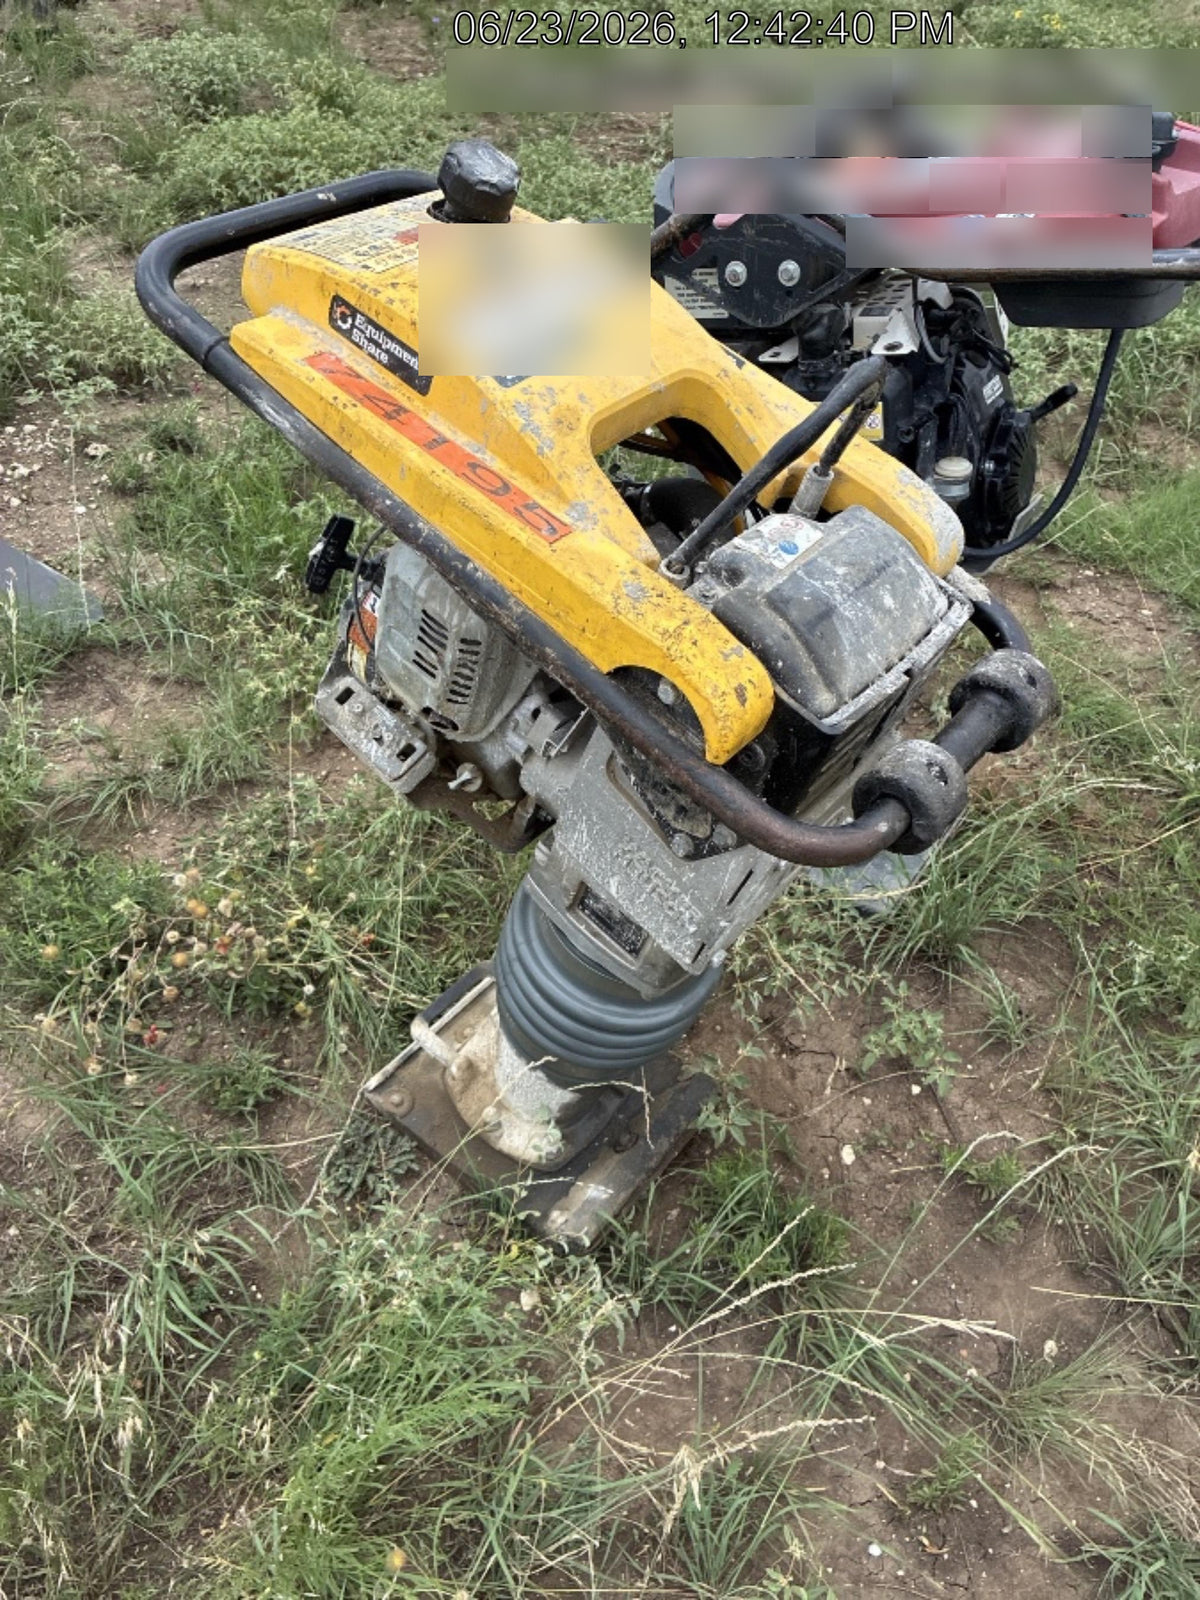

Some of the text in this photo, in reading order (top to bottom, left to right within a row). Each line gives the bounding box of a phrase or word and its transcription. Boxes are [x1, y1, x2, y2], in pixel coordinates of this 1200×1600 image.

[351, 328, 390, 364] Share
[354, 312, 419, 371] Equipmen
[317, 356, 560, 539] 74195
